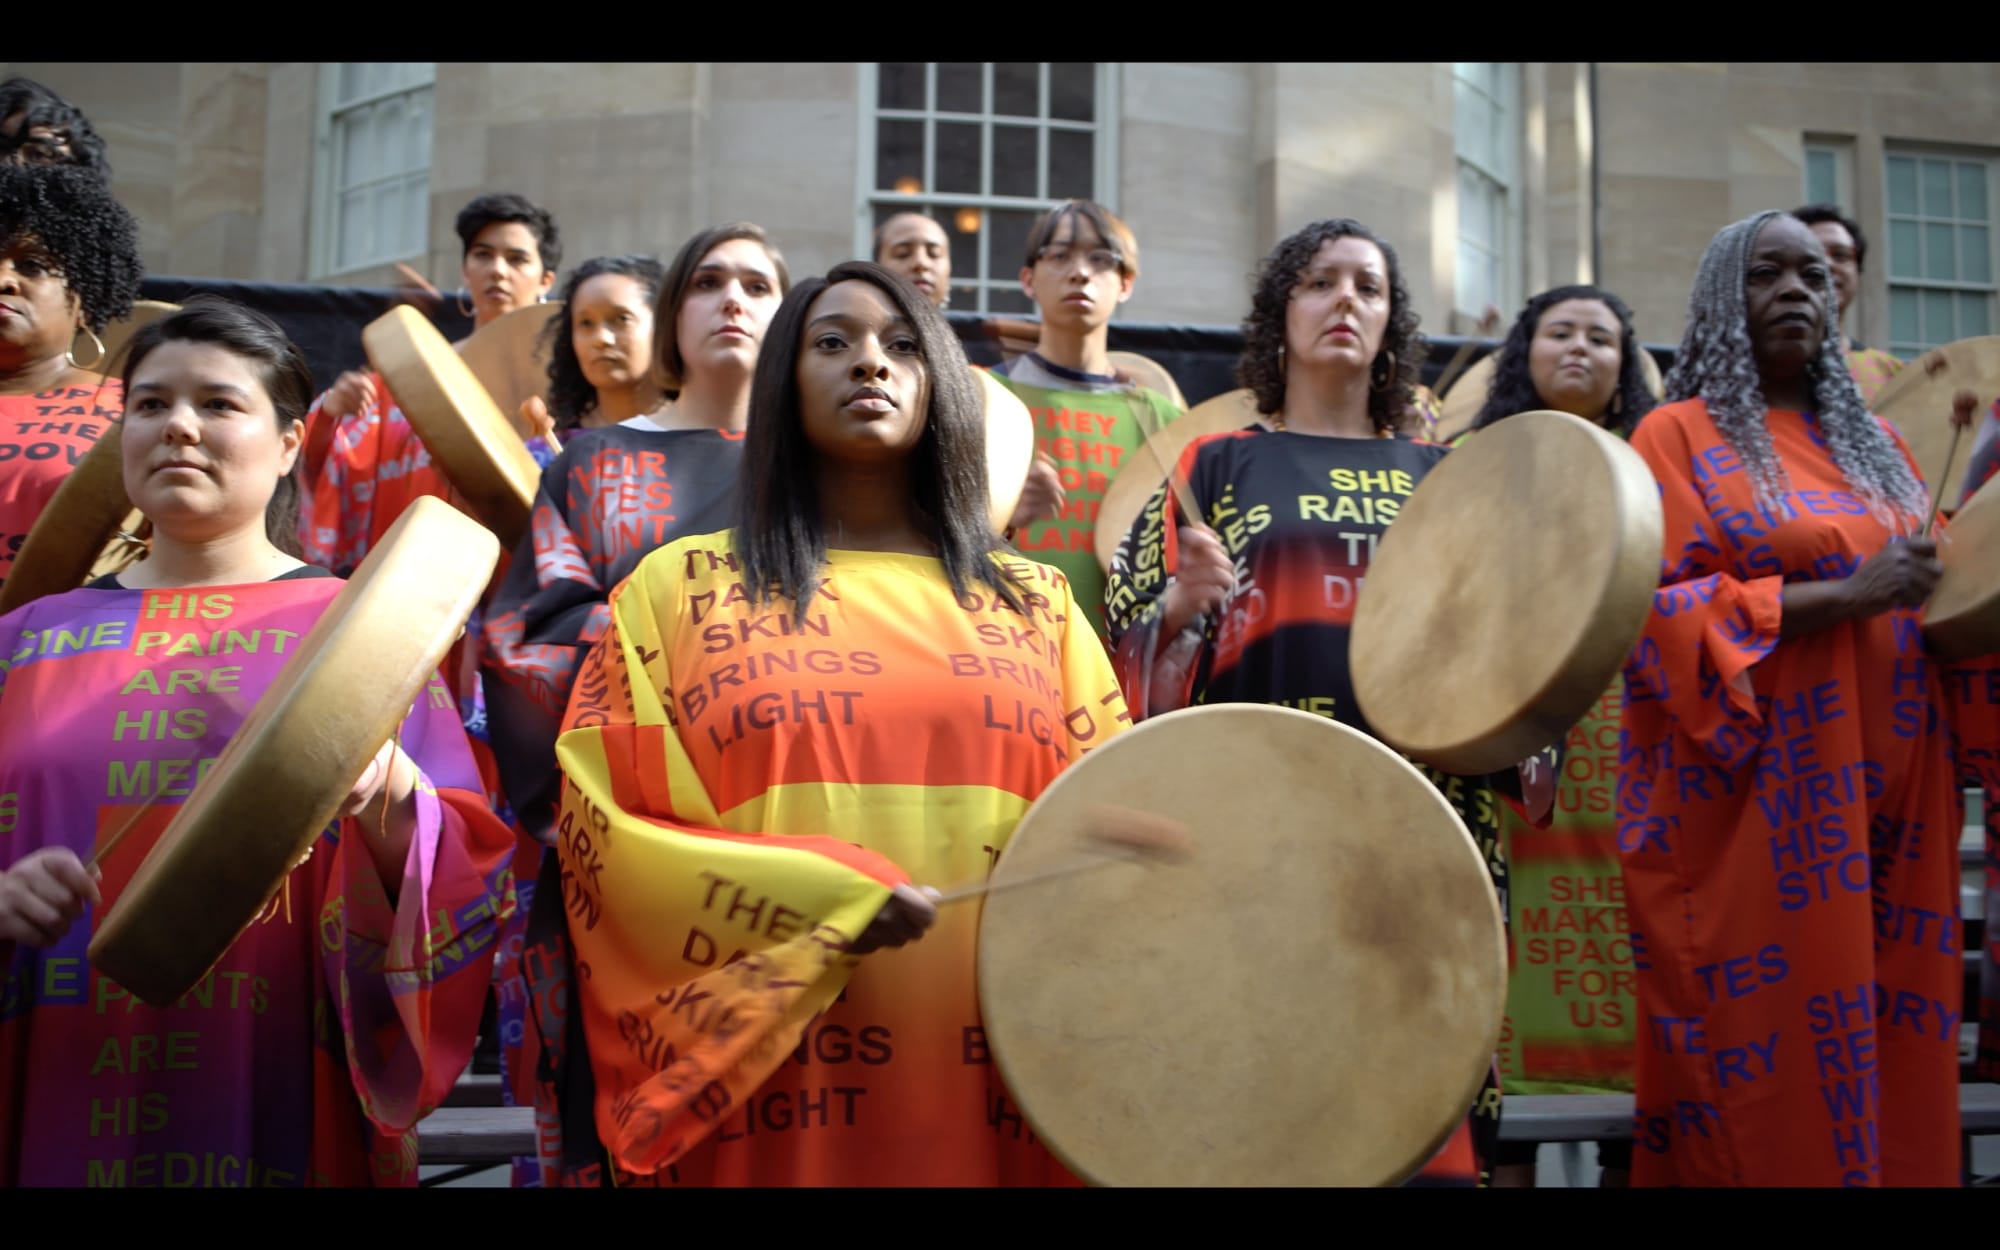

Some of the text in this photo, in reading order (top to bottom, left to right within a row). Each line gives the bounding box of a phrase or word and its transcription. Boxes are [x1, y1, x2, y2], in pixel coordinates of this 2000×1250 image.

[34, 388, 92, 399] UP
[16, 422, 100, 442] THE
[1037, 436, 1125, 468] IGHT
[1329, 468, 1413, 495] SHE
[1299, 495, 1401, 525] RAIS
[1018, 528, 1094, 554] LAN
[145, 593, 234, 619] HIS
[133, 629, 298, 657] PAINT
[702, 613, 831, 654] SKIN
[120, 665, 243, 696] ARE
[680, 649, 883, 726] BRINGS
[112, 708, 208, 741] HIS
[708, 689, 864, 754] LIGHT
[1755, 733, 1822, 790] RE
[1558, 786, 1611, 813] US
[1769, 813, 1850, 873] HIS
[1549, 875, 1628, 902] SHE
[1776, 852, 1871, 912] STO
[1525, 938, 1632, 965] SPAC
[1553, 970, 1637, 997] FOR
[1693, 943, 1790, 1003] TES
[1569, 1001, 1624, 1028] US
[1807, 981, 1878, 1035] SH
[90, 1031, 200, 1076] ARE
[1715, 1031, 1781, 1089] RY
[1815, 1029, 1877, 1080] RE
[88, 1092, 169, 1137] HIS
